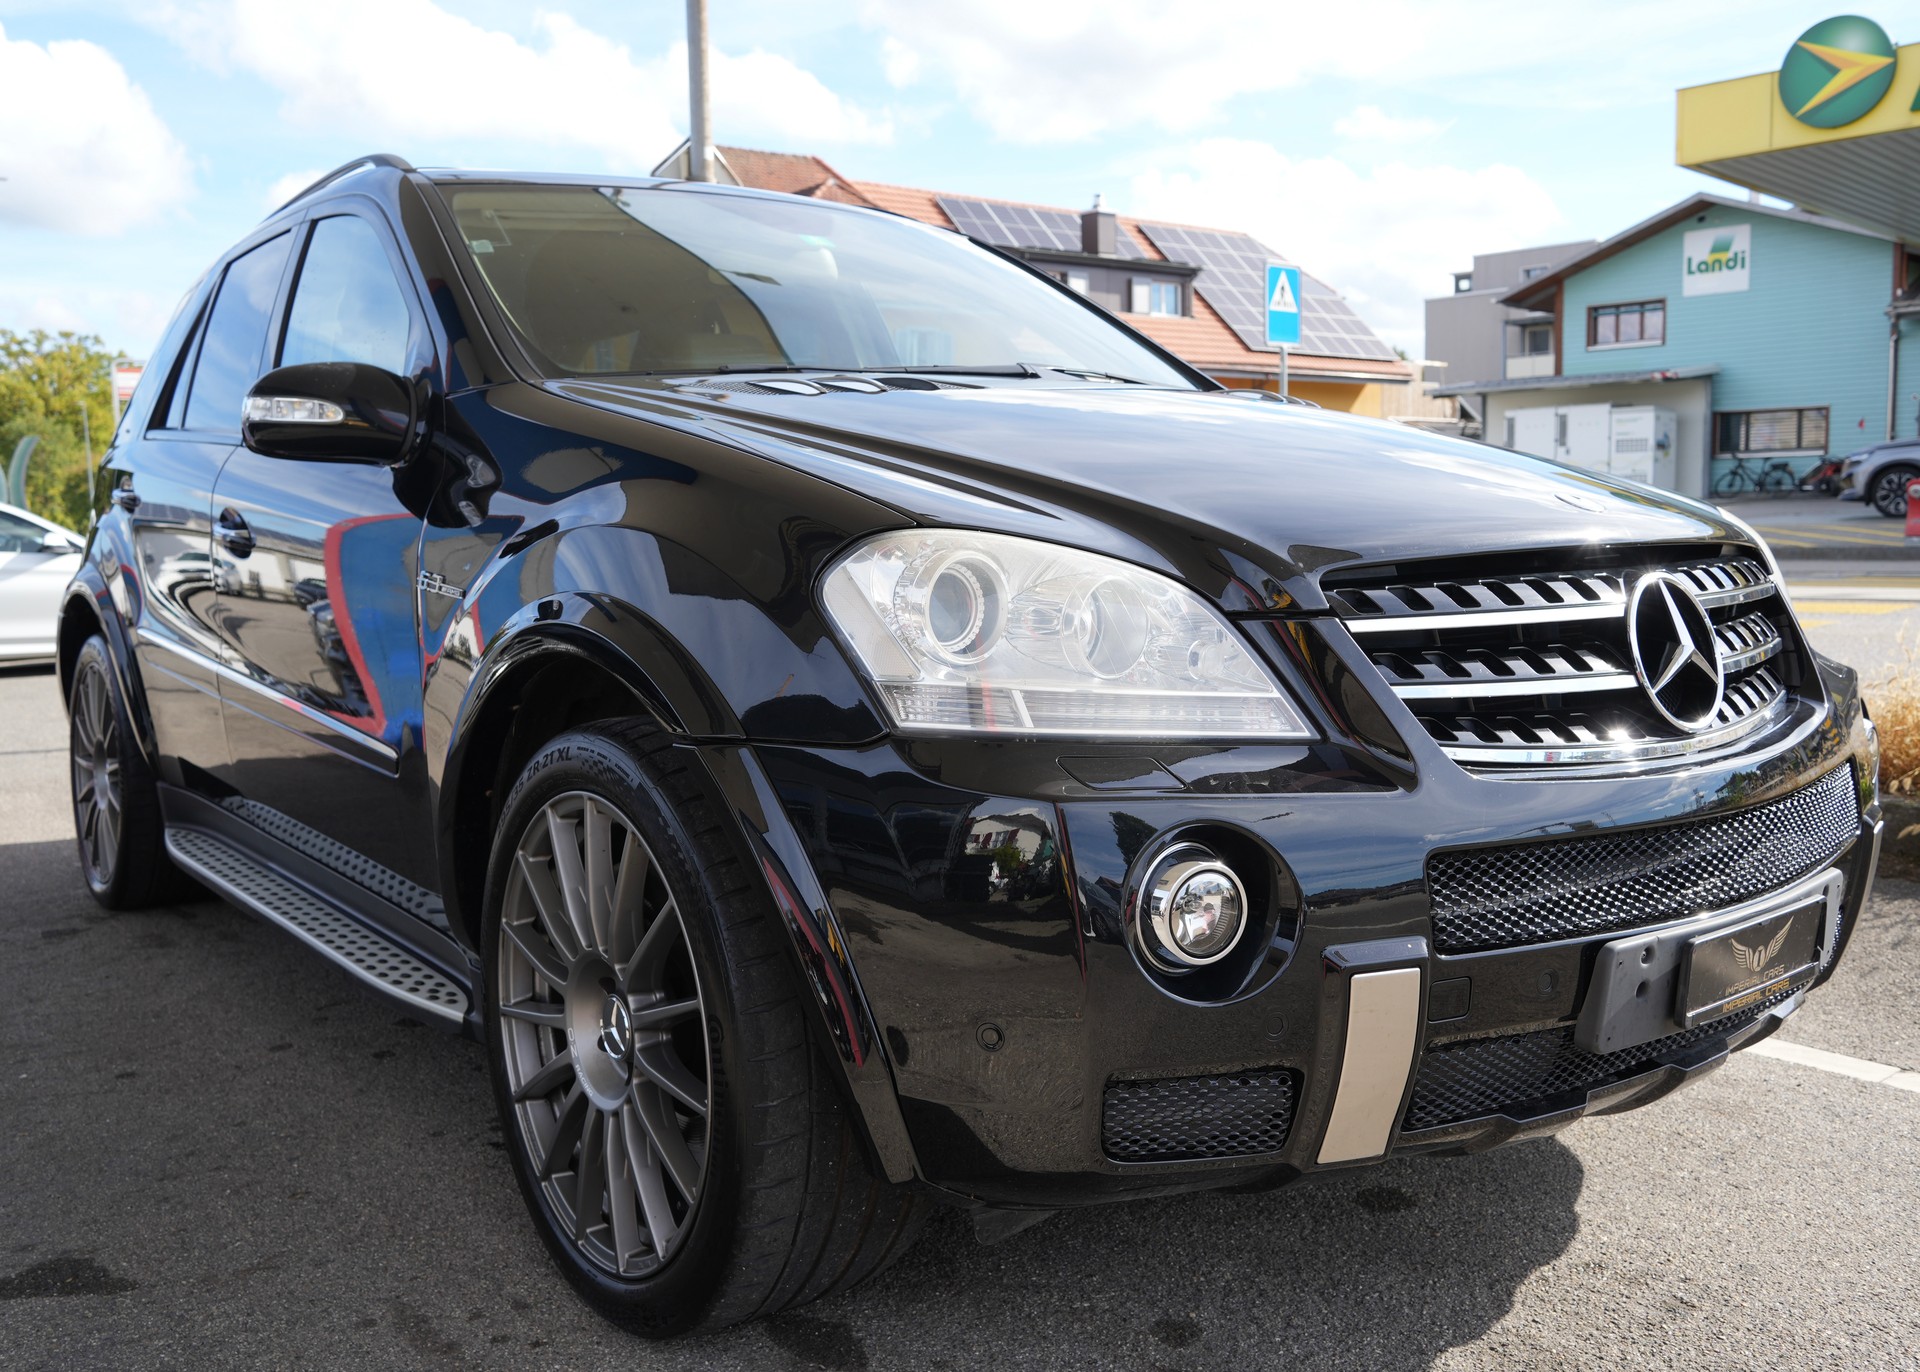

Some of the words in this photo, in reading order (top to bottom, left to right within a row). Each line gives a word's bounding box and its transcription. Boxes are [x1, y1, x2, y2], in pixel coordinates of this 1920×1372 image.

[1687, 250, 1746, 276] Landi
[416, 570, 445, 594] 63
[557, 746, 572, 762] XL
[1724, 975, 1761, 996] IMPERIAL
[1763, 964, 1785, 981] CARS
[1722, 991, 1763, 1013] IMPERIAL
[1765, 977, 1790, 996] CARS
